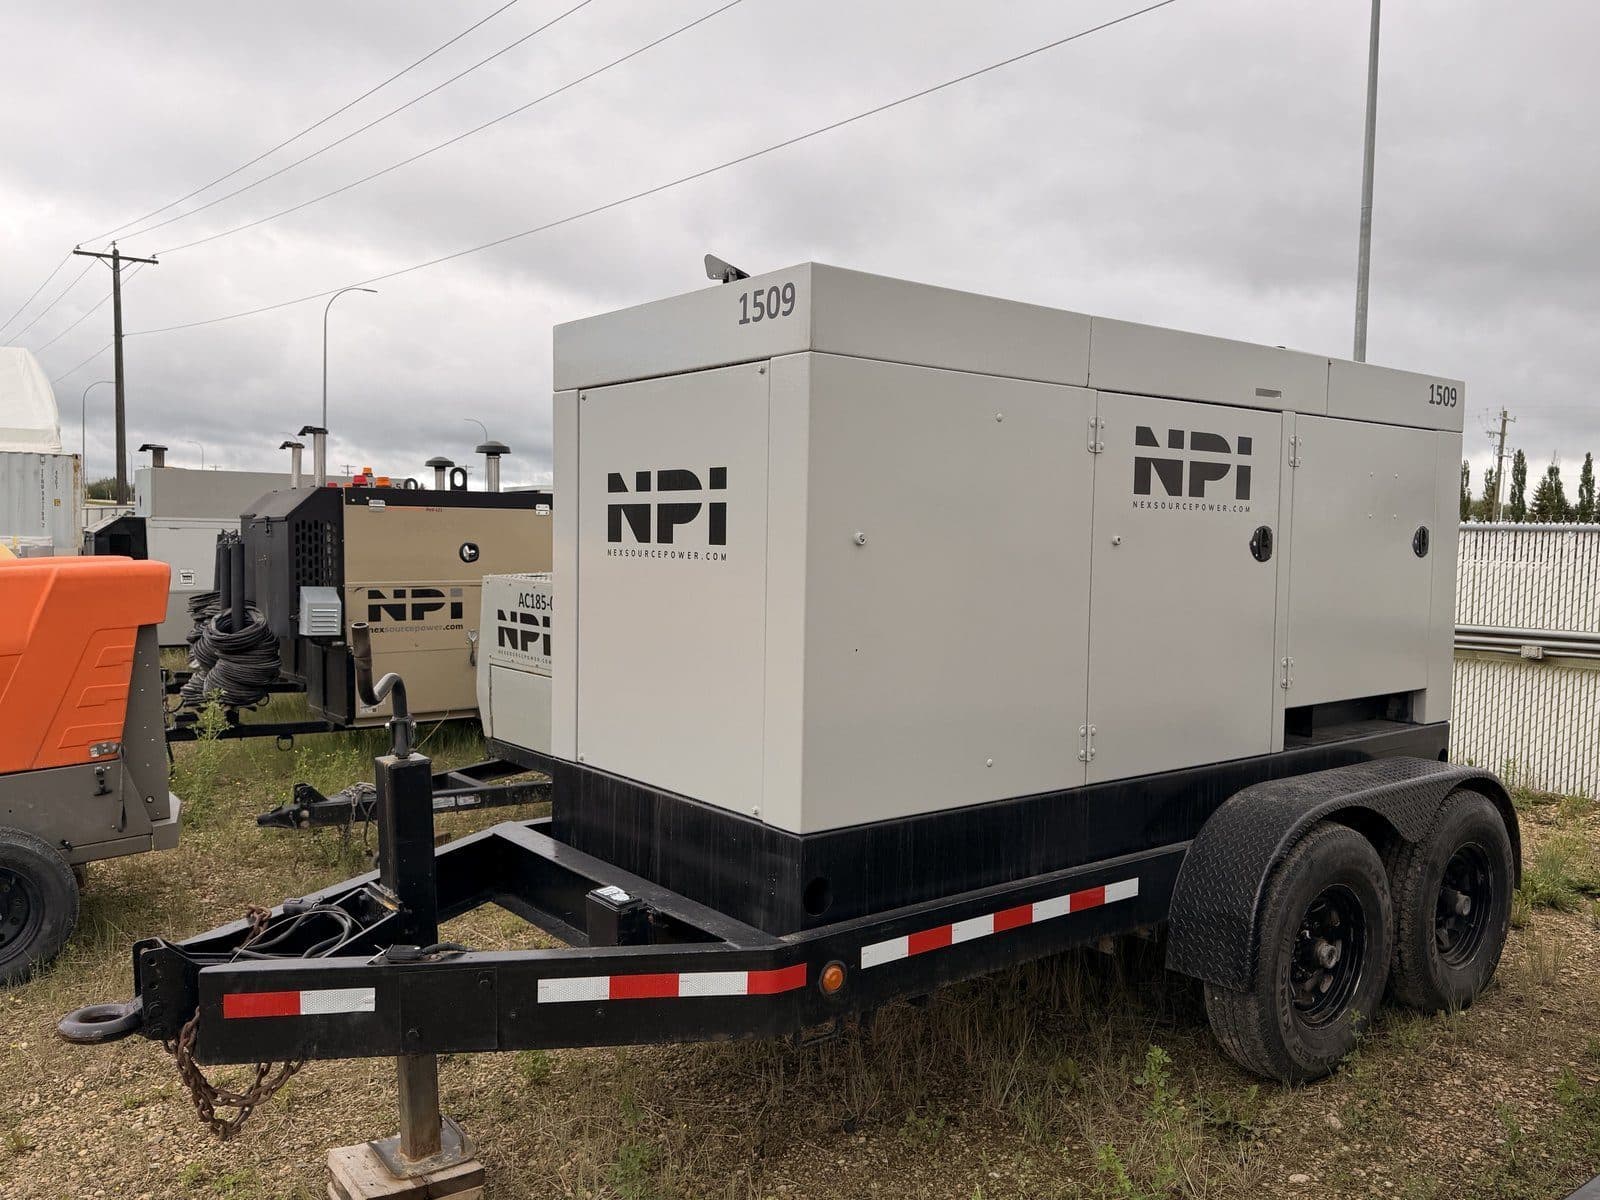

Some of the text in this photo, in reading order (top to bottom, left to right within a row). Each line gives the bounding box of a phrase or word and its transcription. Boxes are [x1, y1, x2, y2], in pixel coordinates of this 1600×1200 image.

[739, 282, 796, 324] 1509
[1429, 383, 1457, 408] 1509
[1133, 425, 1253, 500] NPI
[607, 466, 727, 545] NPI
[1132, 500, 1251, 513] NEXSOURCEPOWER.COM
[607, 548, 727, 561] NEXSOURCEPOWER.COM
